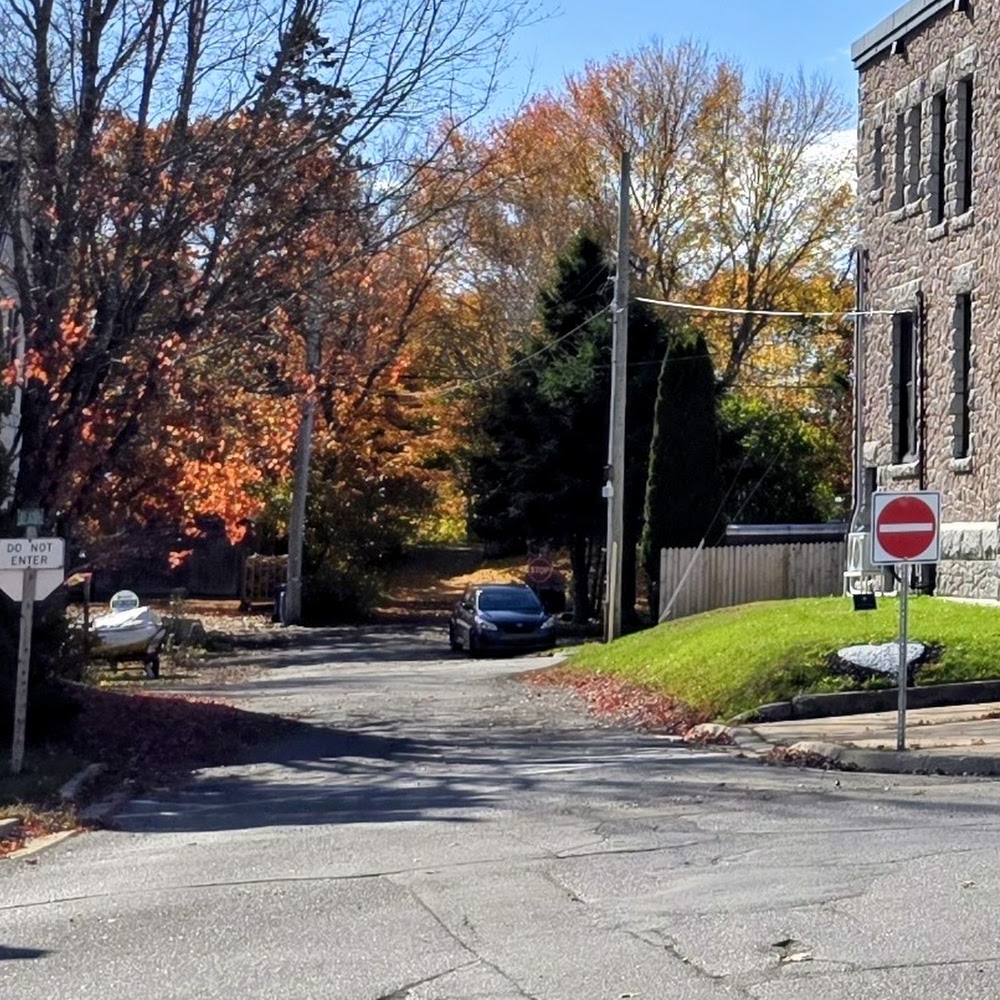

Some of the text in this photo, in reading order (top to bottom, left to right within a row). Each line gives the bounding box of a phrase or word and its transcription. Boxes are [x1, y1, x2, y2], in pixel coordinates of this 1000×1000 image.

[7, 542, 53, 553] DO NOT
[11, 555, 48, 566] ENTER
